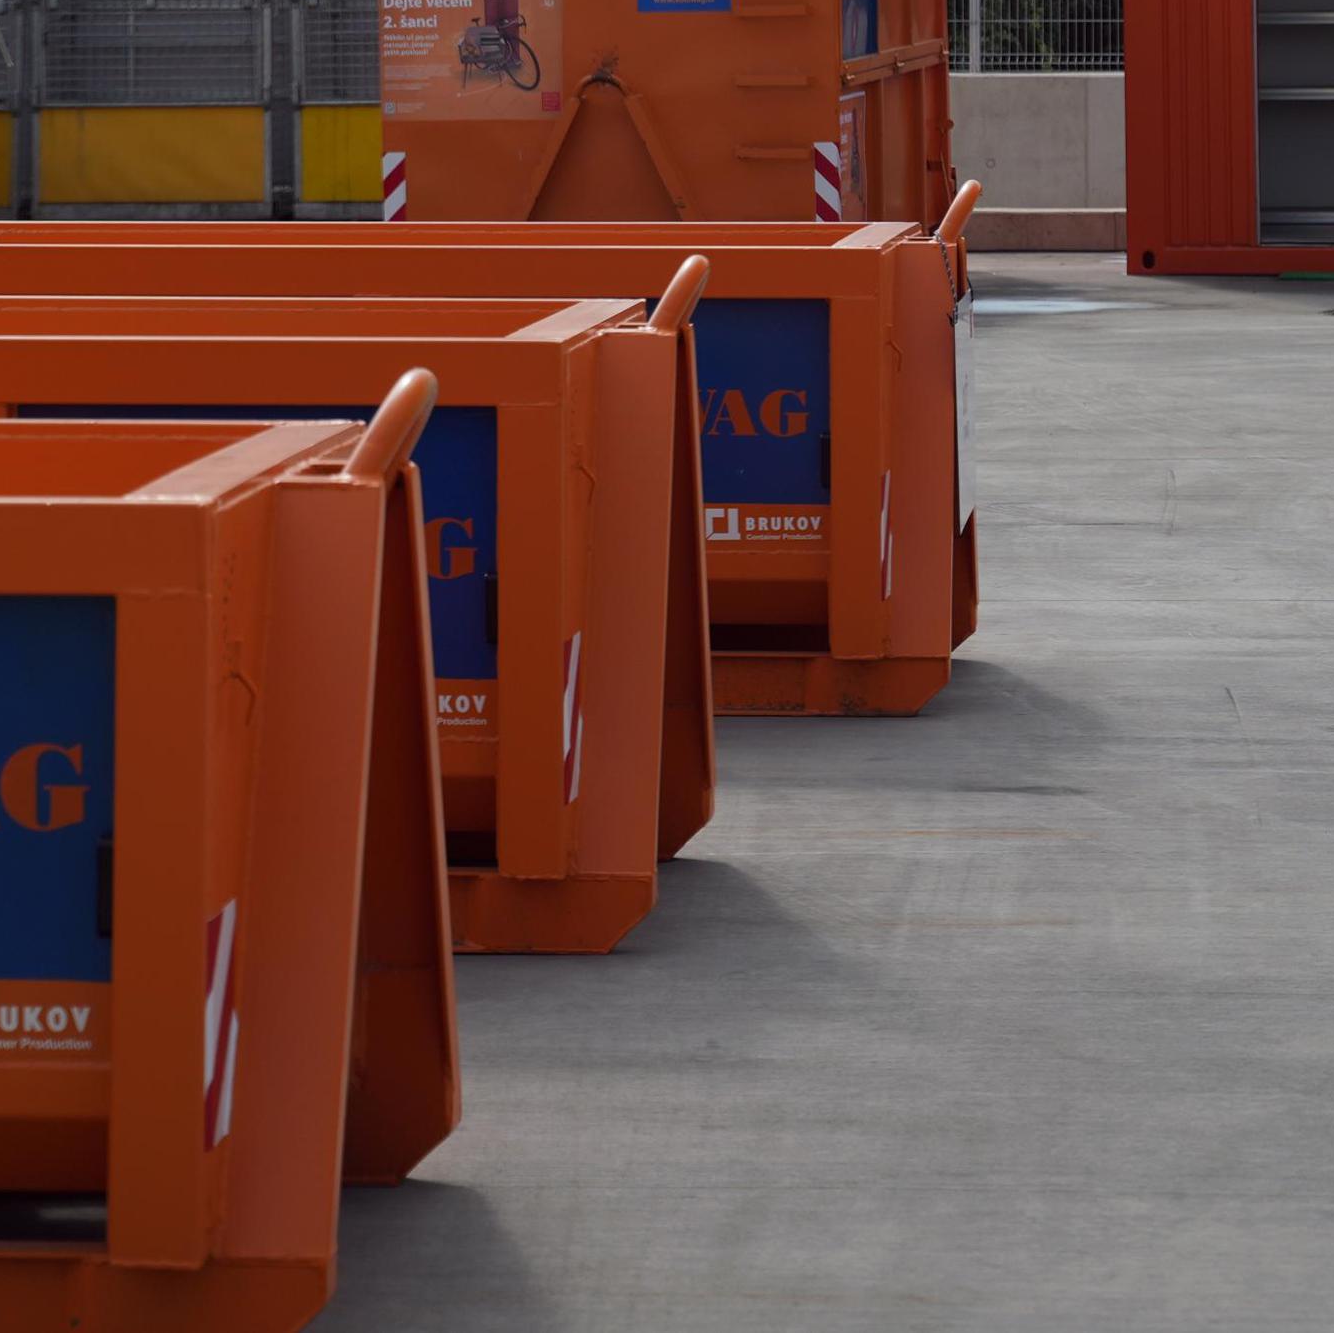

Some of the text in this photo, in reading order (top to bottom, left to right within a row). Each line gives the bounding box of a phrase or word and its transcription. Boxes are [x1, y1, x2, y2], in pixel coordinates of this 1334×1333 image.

[384, 14, 438, 28] 2. šanci
[745, 516, 822, 532] BRUKOV
[20, 1036, 93, 1051] Production
